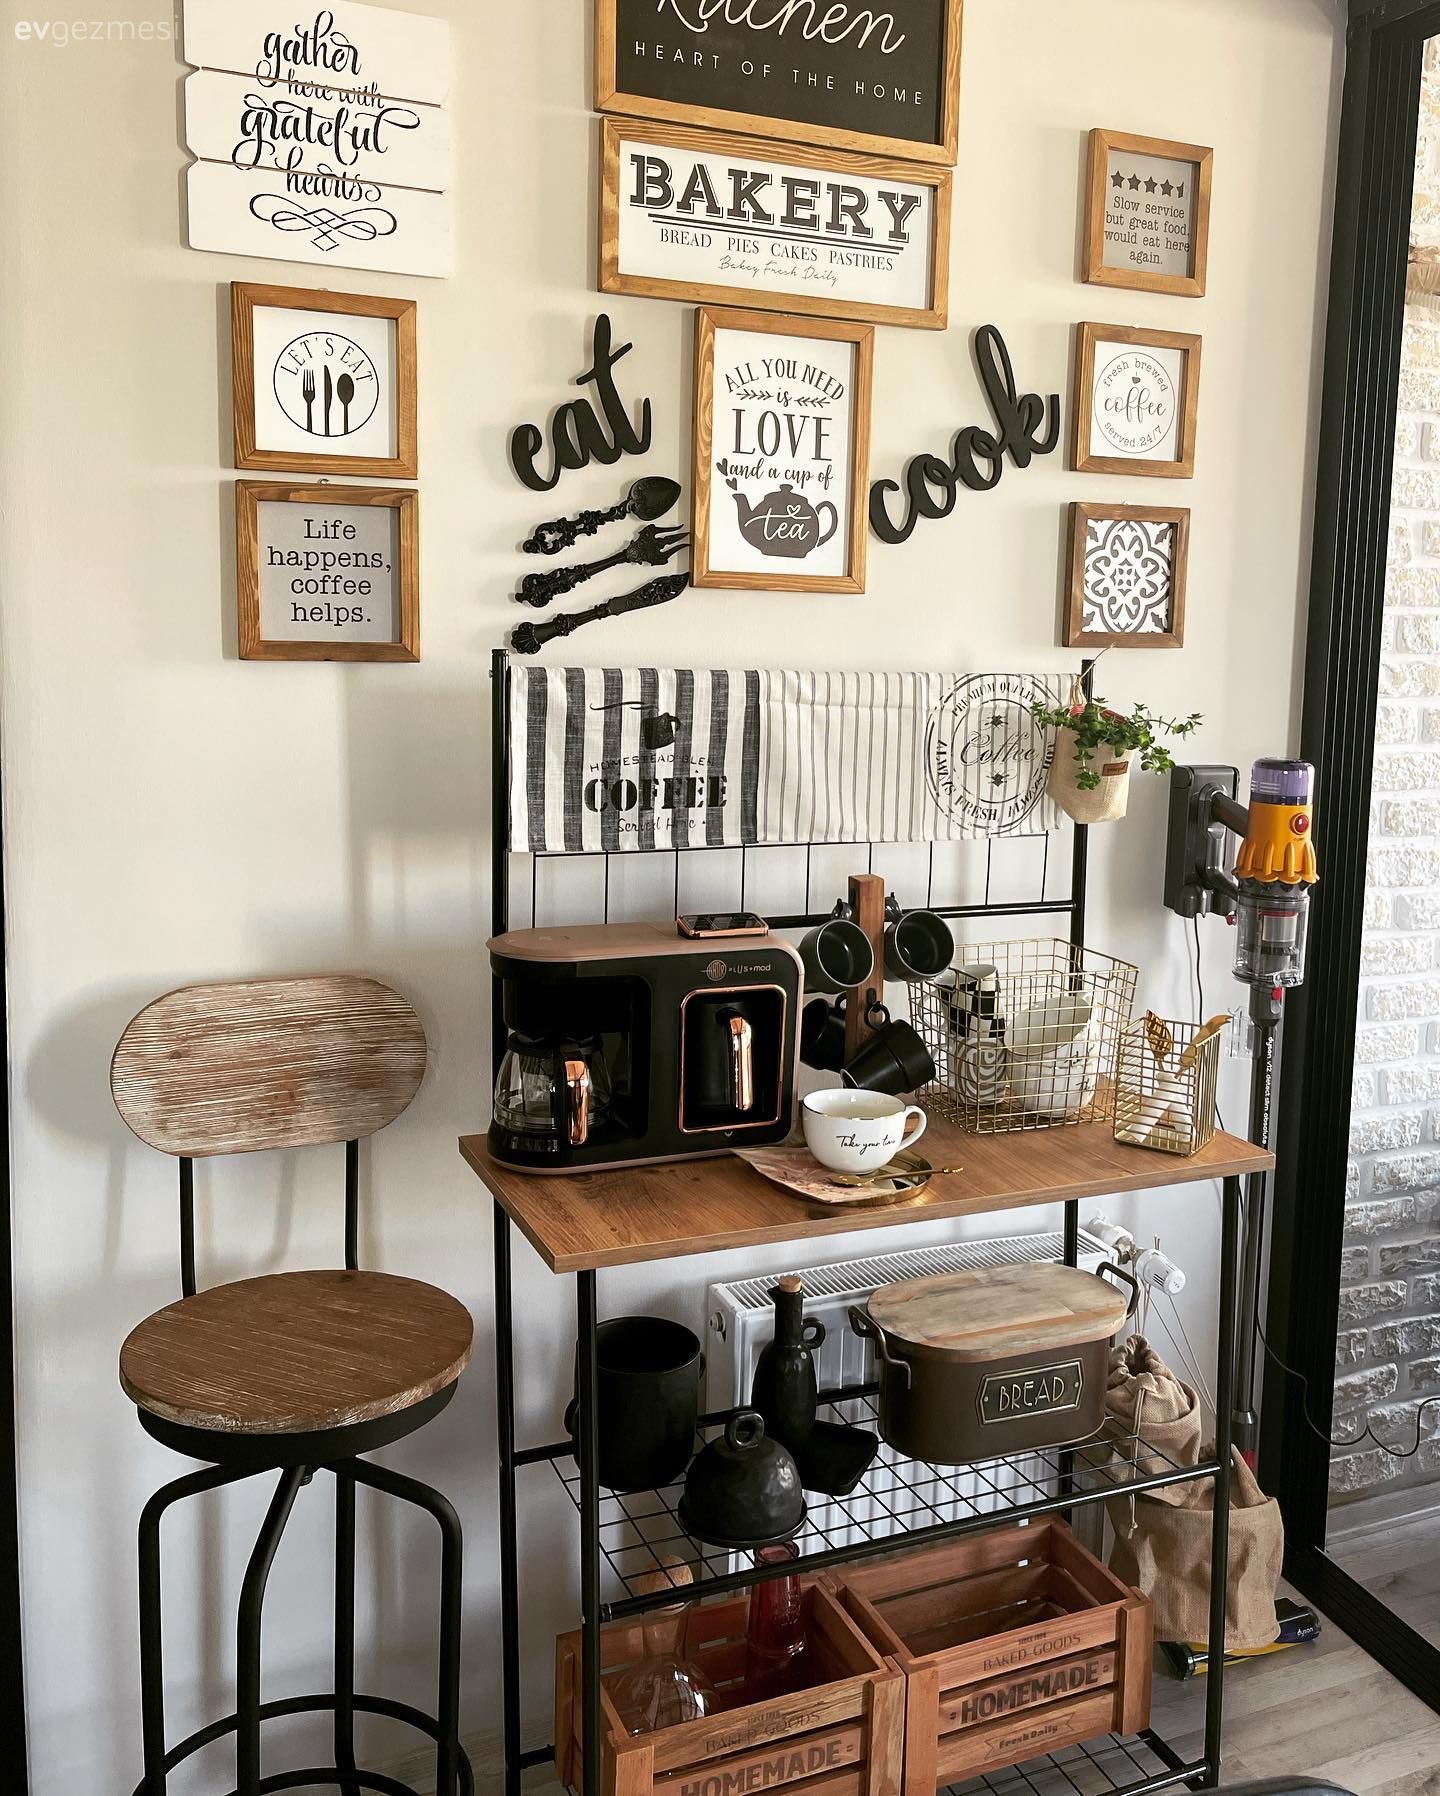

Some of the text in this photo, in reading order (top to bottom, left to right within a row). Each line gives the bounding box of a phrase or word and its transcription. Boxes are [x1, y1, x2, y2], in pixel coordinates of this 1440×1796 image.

[256, 10, 362, 88] gather
[286, 68, 385, 109] here with
[635, 41, 923, 105] HEART OF THE HOME
[232, 93, 420, 170] grateful
[274, 145, 381, 202] hearts
[629, 153, 921, 243] BAKERY
[1113, 195, 1184, 219] Slow service
[1105, 211, 1124, 226] but
[1129, 216, 1159, 231] great
[660, 228, 893, 271] BREAD PIES CAKES PASTRIES
[1104, 230, 1190, 253] would eat here
[1129, 250, 1163, 265] again.
[763, 260, 797, 278] Fresh
[801, 265, 839, 287] Daily
[280, 337, 373, 381] LET'S EAT
[1103, 357, 1169, 392] fresh brewed
[725, 358, 844, 401] ALL YOU NEED
[776, 387, 792, 407] is
[511, 313, 652, 492] eat
[1104, 386, 1167, 424] coffee
[732, 408, 833, 462] LOVE
[869, 324, 1061, 545] cook
[1104, 421, 1162, 448] served 24/7
[729, 458, 833, 490] and a cup of
[303, 519, 357, 540] Life
[744, 505, 811, 541] tea
[267, 546, 392, 573] happens,
[290, 575, 372, 596] coffee
[290, 602, 372, 627] helps.
[951, 682, 1039, 717] PREMIUM QUALIT
[960, 731, 1038, 767] Coffee
[584, 776, 727, 812] COFFEE
[954, 794, 998, 821] FRESH
[1266, 1036, 1274, 1059] dyson
[1264, 1074, 1272, 1096] detect
[836, 1133, 860, 1148] Take
[860, 1142, 880, 1155] your
[1262, 1112, 1270, 1145] absolute
[999, 1376, 1065, 1412] BREAD
[1033, 1634, 1081, 1656] GOODS
[1296, 1627, 1314, 1638] dyson
[960, 1660, 1099, 1724] HOMEMADE
